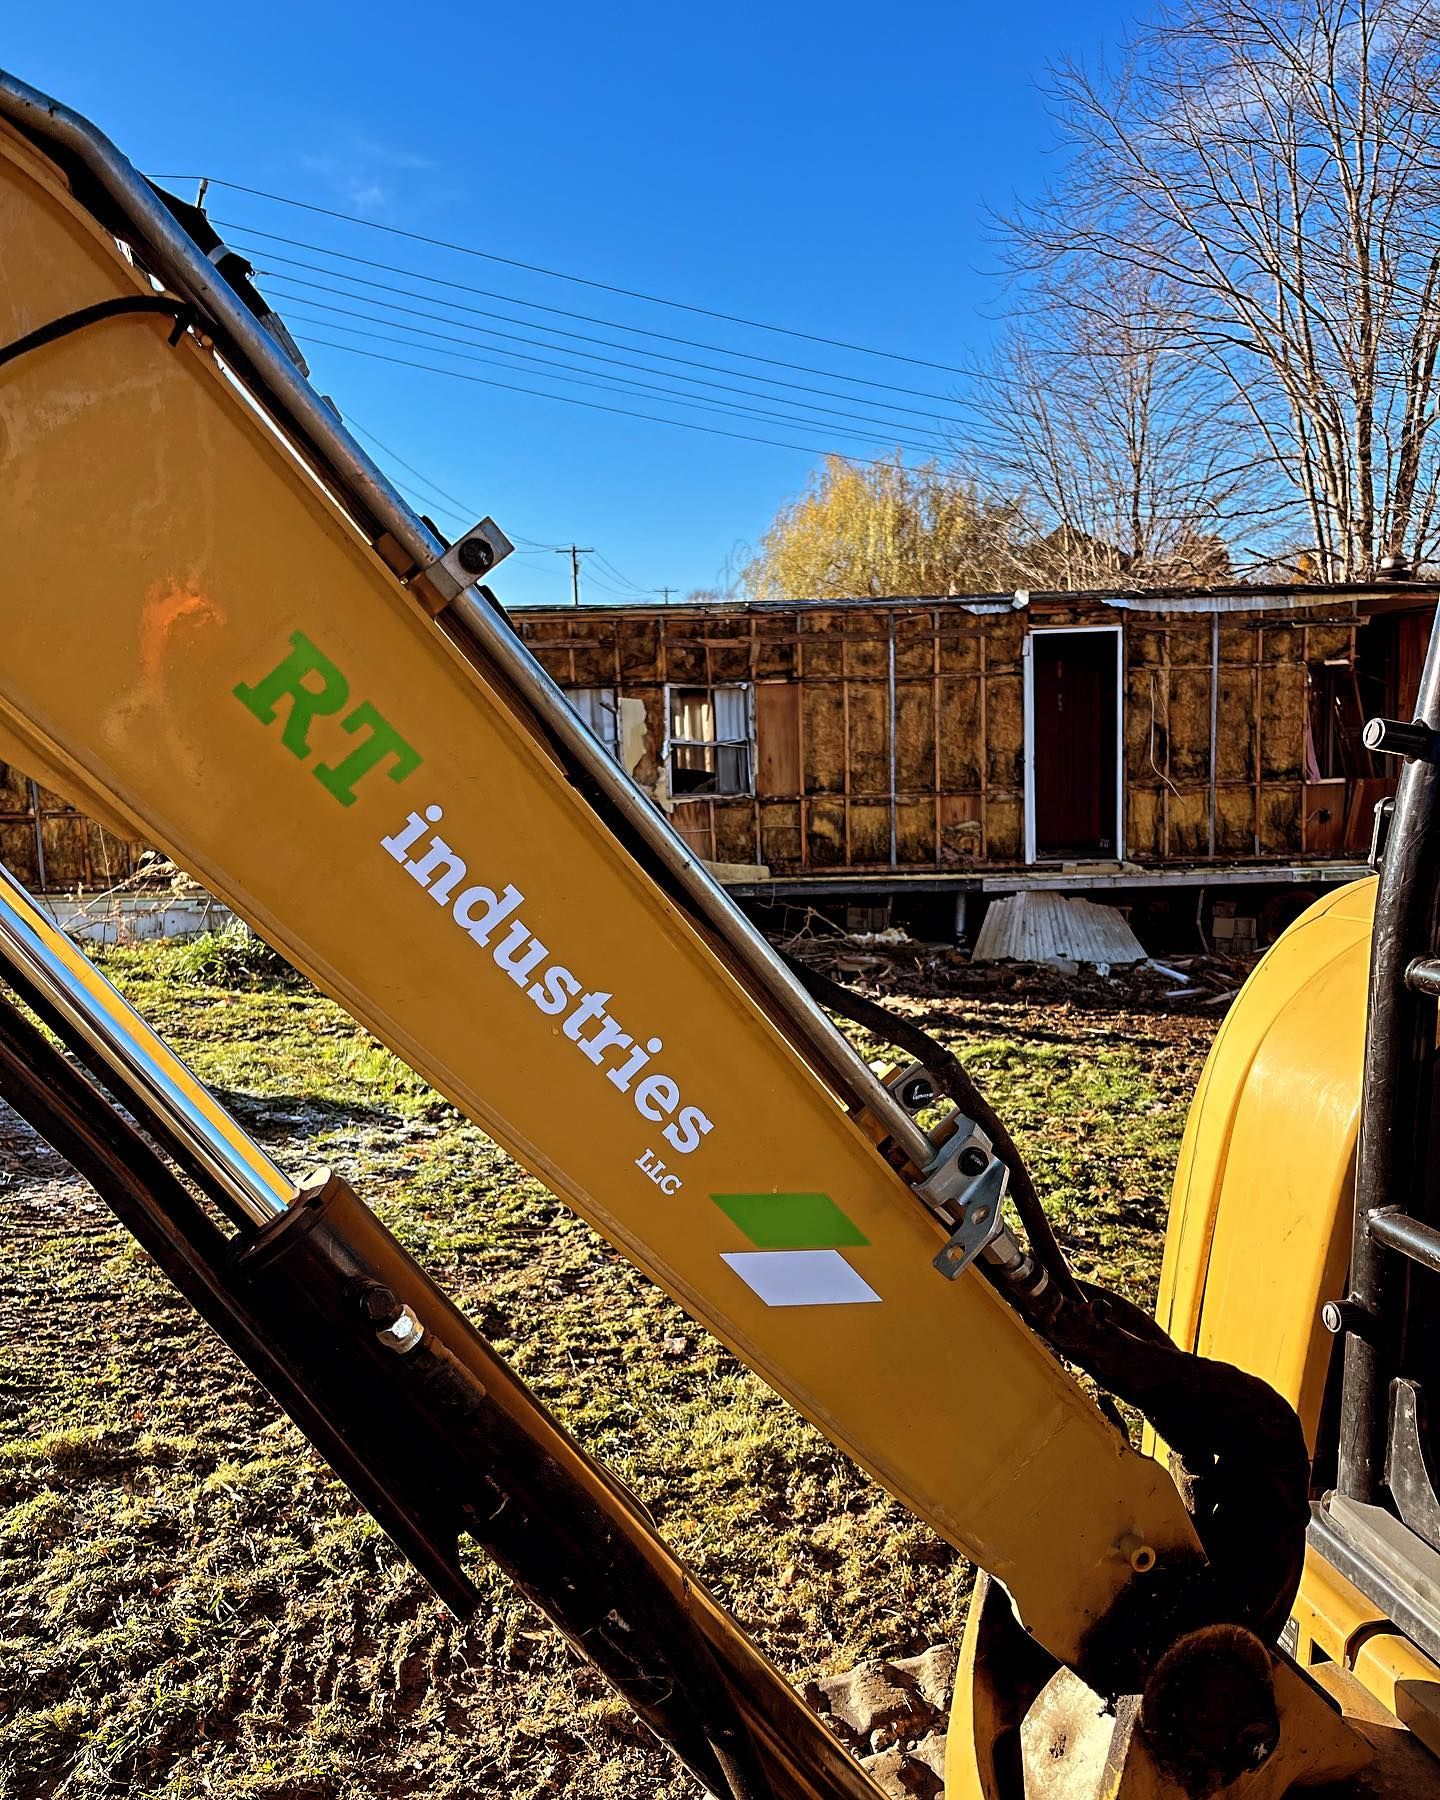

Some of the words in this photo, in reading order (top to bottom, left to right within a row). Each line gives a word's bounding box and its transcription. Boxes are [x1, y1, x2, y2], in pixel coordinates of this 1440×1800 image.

[234, 631, 422, 806] RT
[380, 804, 715, 1154] industries
[635, 1149, 683, 1195] LLC
